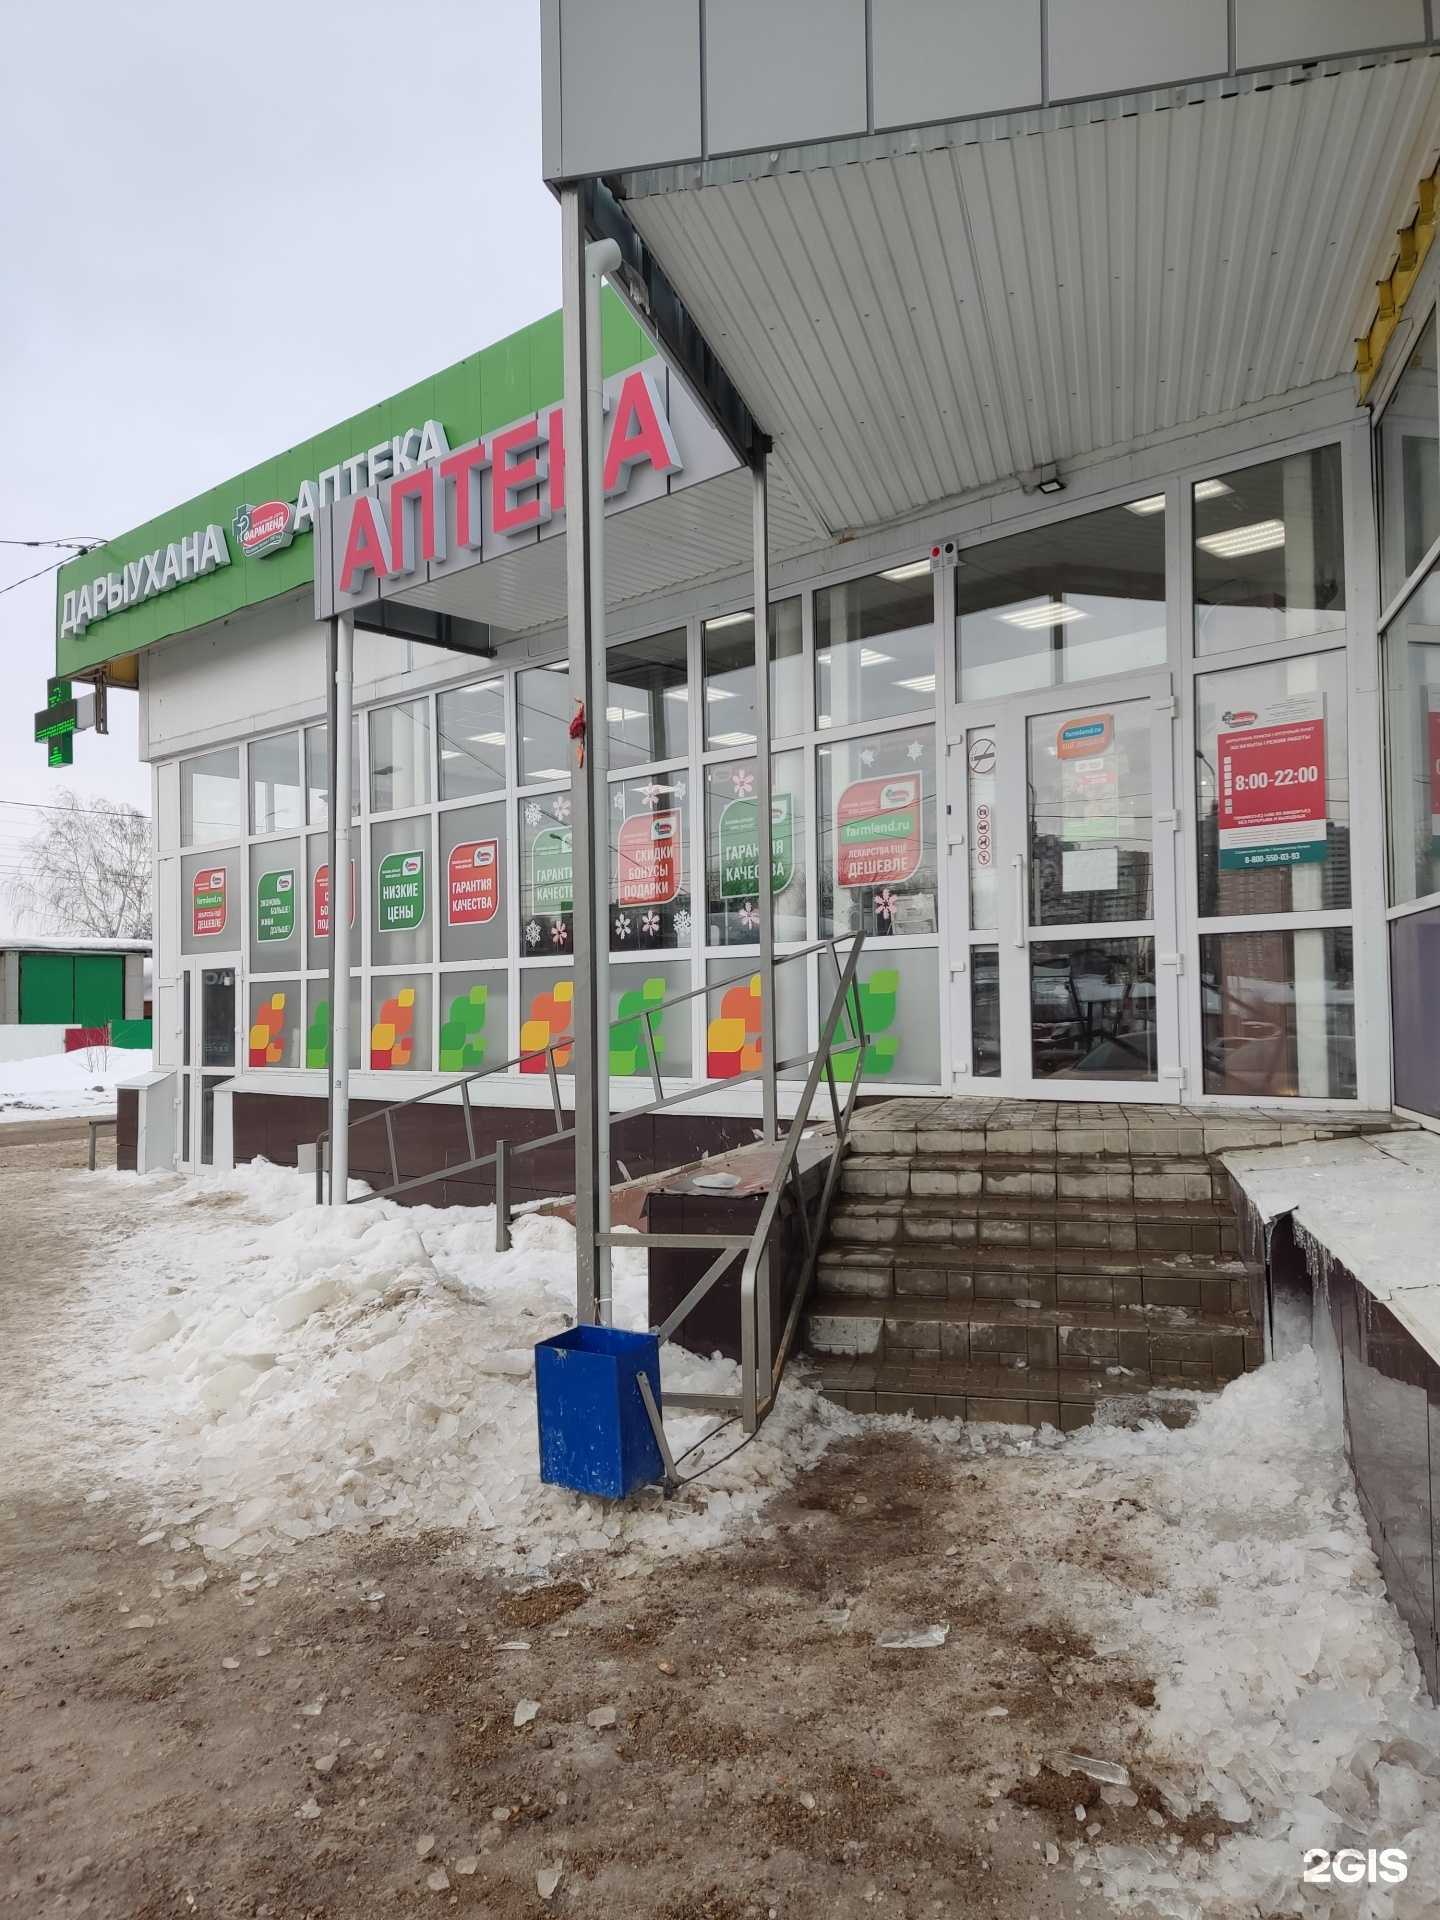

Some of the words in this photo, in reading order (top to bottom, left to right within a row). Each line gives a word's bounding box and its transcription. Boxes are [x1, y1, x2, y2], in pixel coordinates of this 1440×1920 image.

[294, 420, 449, 529] АПТЕКА
[61, 524, 230, 638] ДАРЫУХАНА
[1235, 766, 1318, 790] 8:00-22:00
[635, 846, 673, 862] СКИДКИ
[629, 863, 669, 880] БОНУСЫ
[848, 857, 909, 879] ДЕШЕВЛЕ
[383, 882, 419, 900] НИЗКИЕ
[451, 878, 492, 895] ГАРАНТИЯ
[624, 881, 669, 898] ПОДАРКИ
[452, 896, 493, 912] КАЧЕСТВА
[387, 904, 414, 923] ЦЕНЫ
